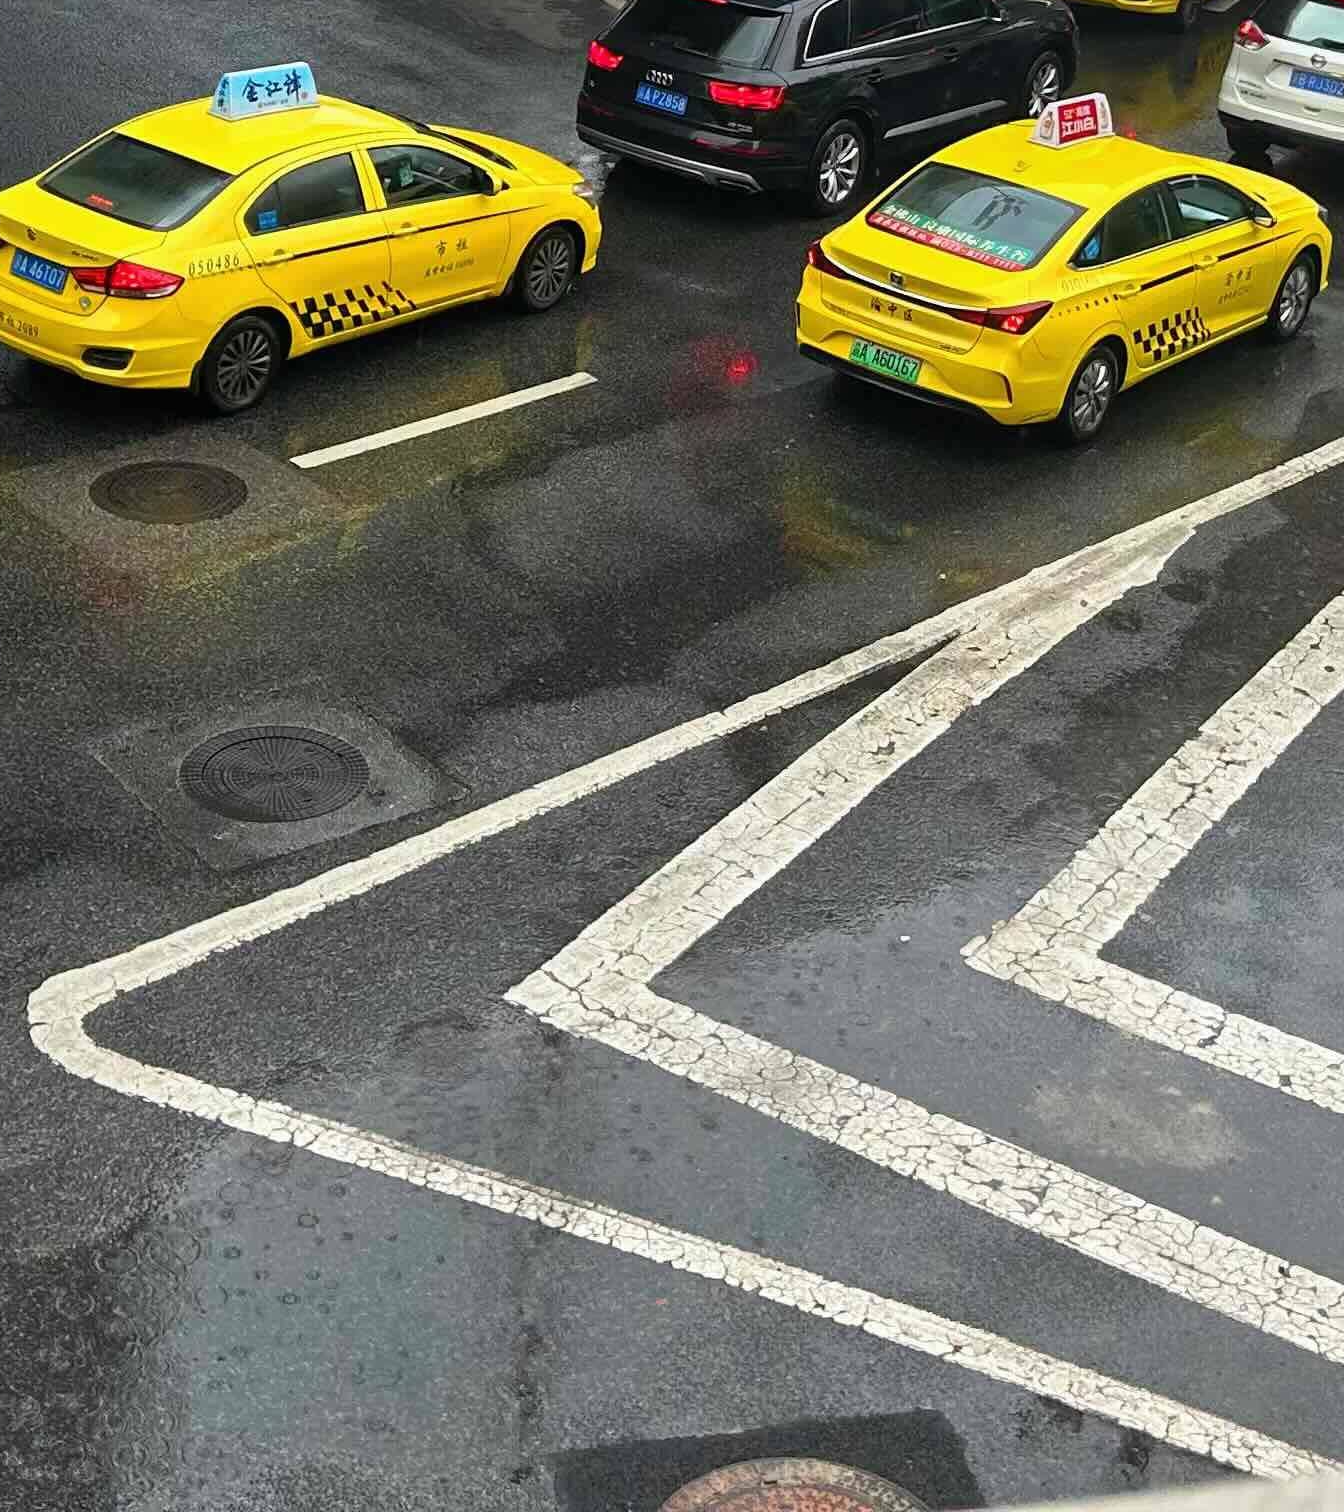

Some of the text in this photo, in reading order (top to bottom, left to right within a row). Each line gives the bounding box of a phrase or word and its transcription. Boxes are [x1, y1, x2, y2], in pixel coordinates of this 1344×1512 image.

[1061, 117, 1094, 137] 江小白
[188, 252, 240, 279] 050486
